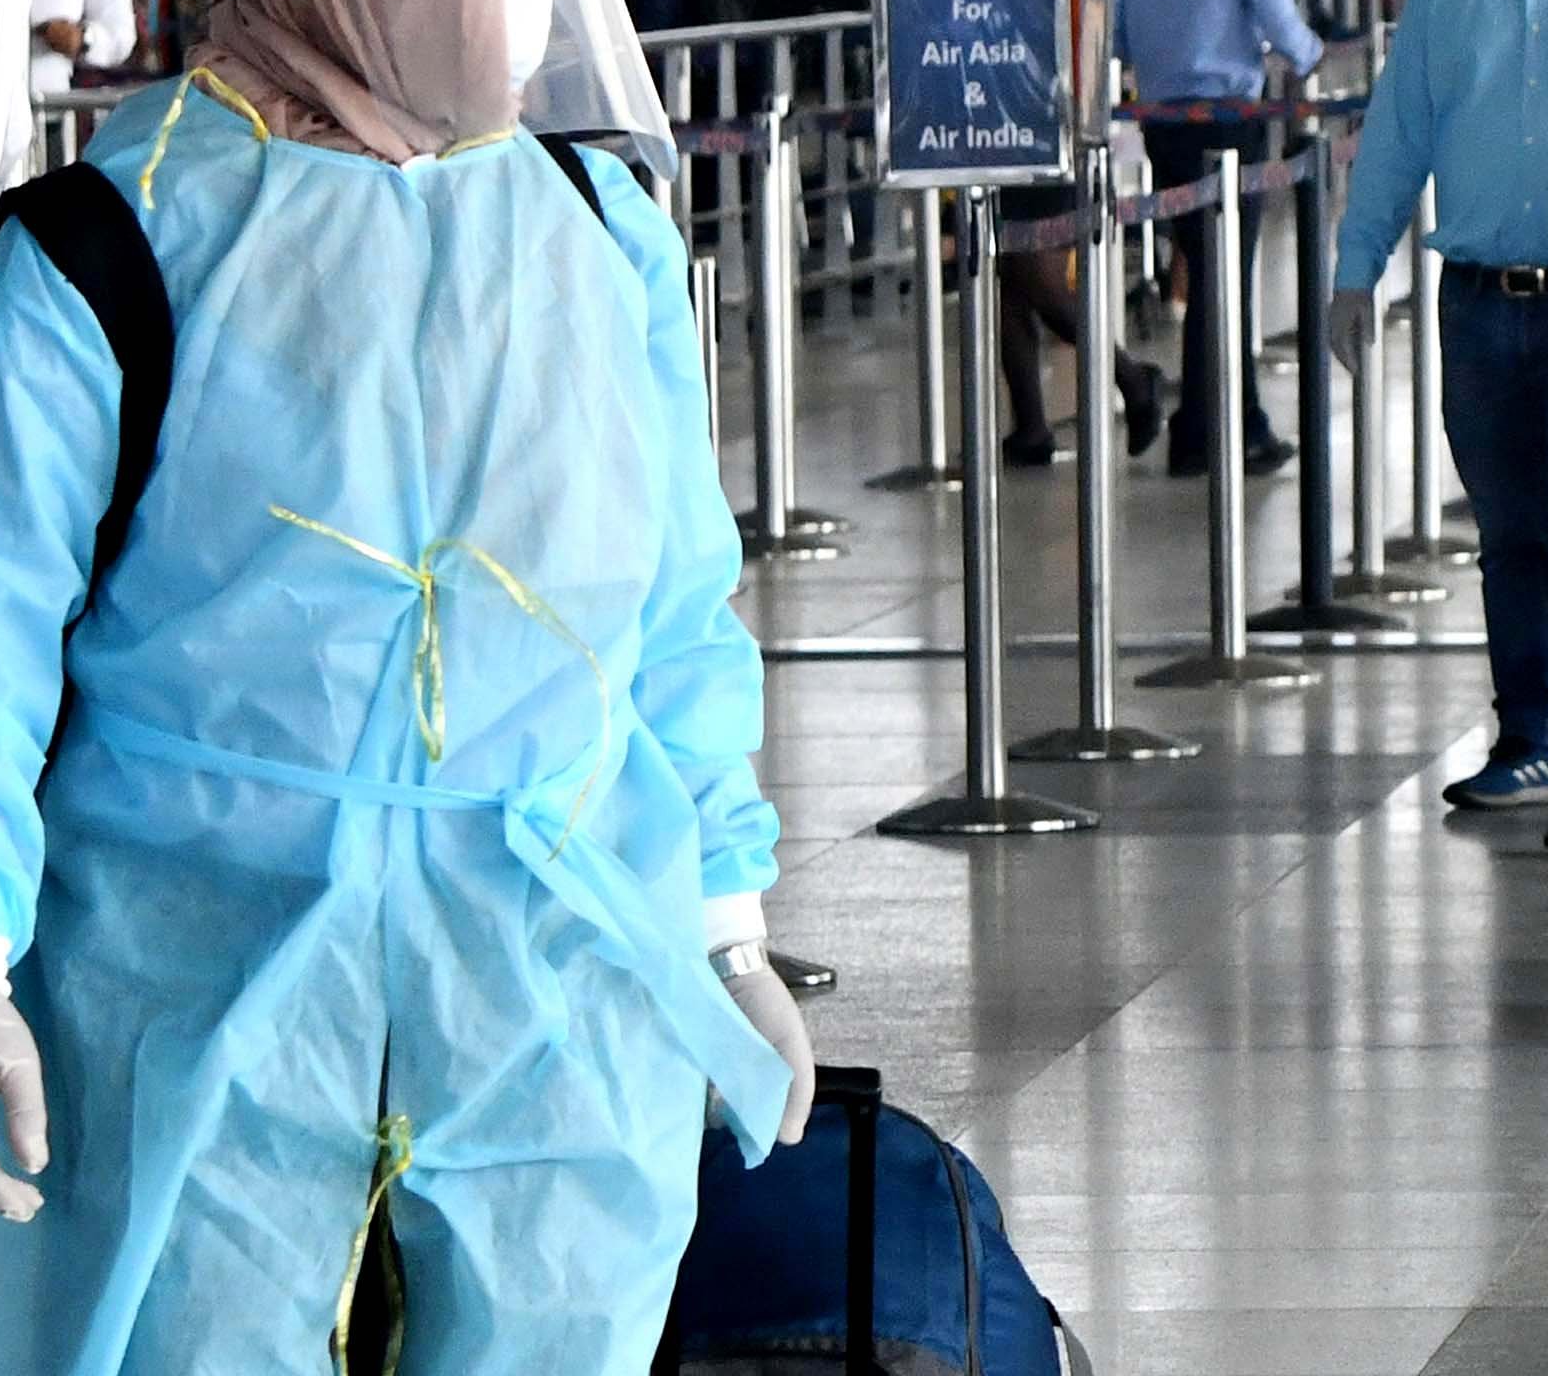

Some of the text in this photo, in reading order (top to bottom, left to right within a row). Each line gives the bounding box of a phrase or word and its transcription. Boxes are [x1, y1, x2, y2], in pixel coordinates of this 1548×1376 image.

[921, 39, 1026, 67] Air Asia
[963, 80, 988, 108] &
[918, 122, 1035, 151] Air India
